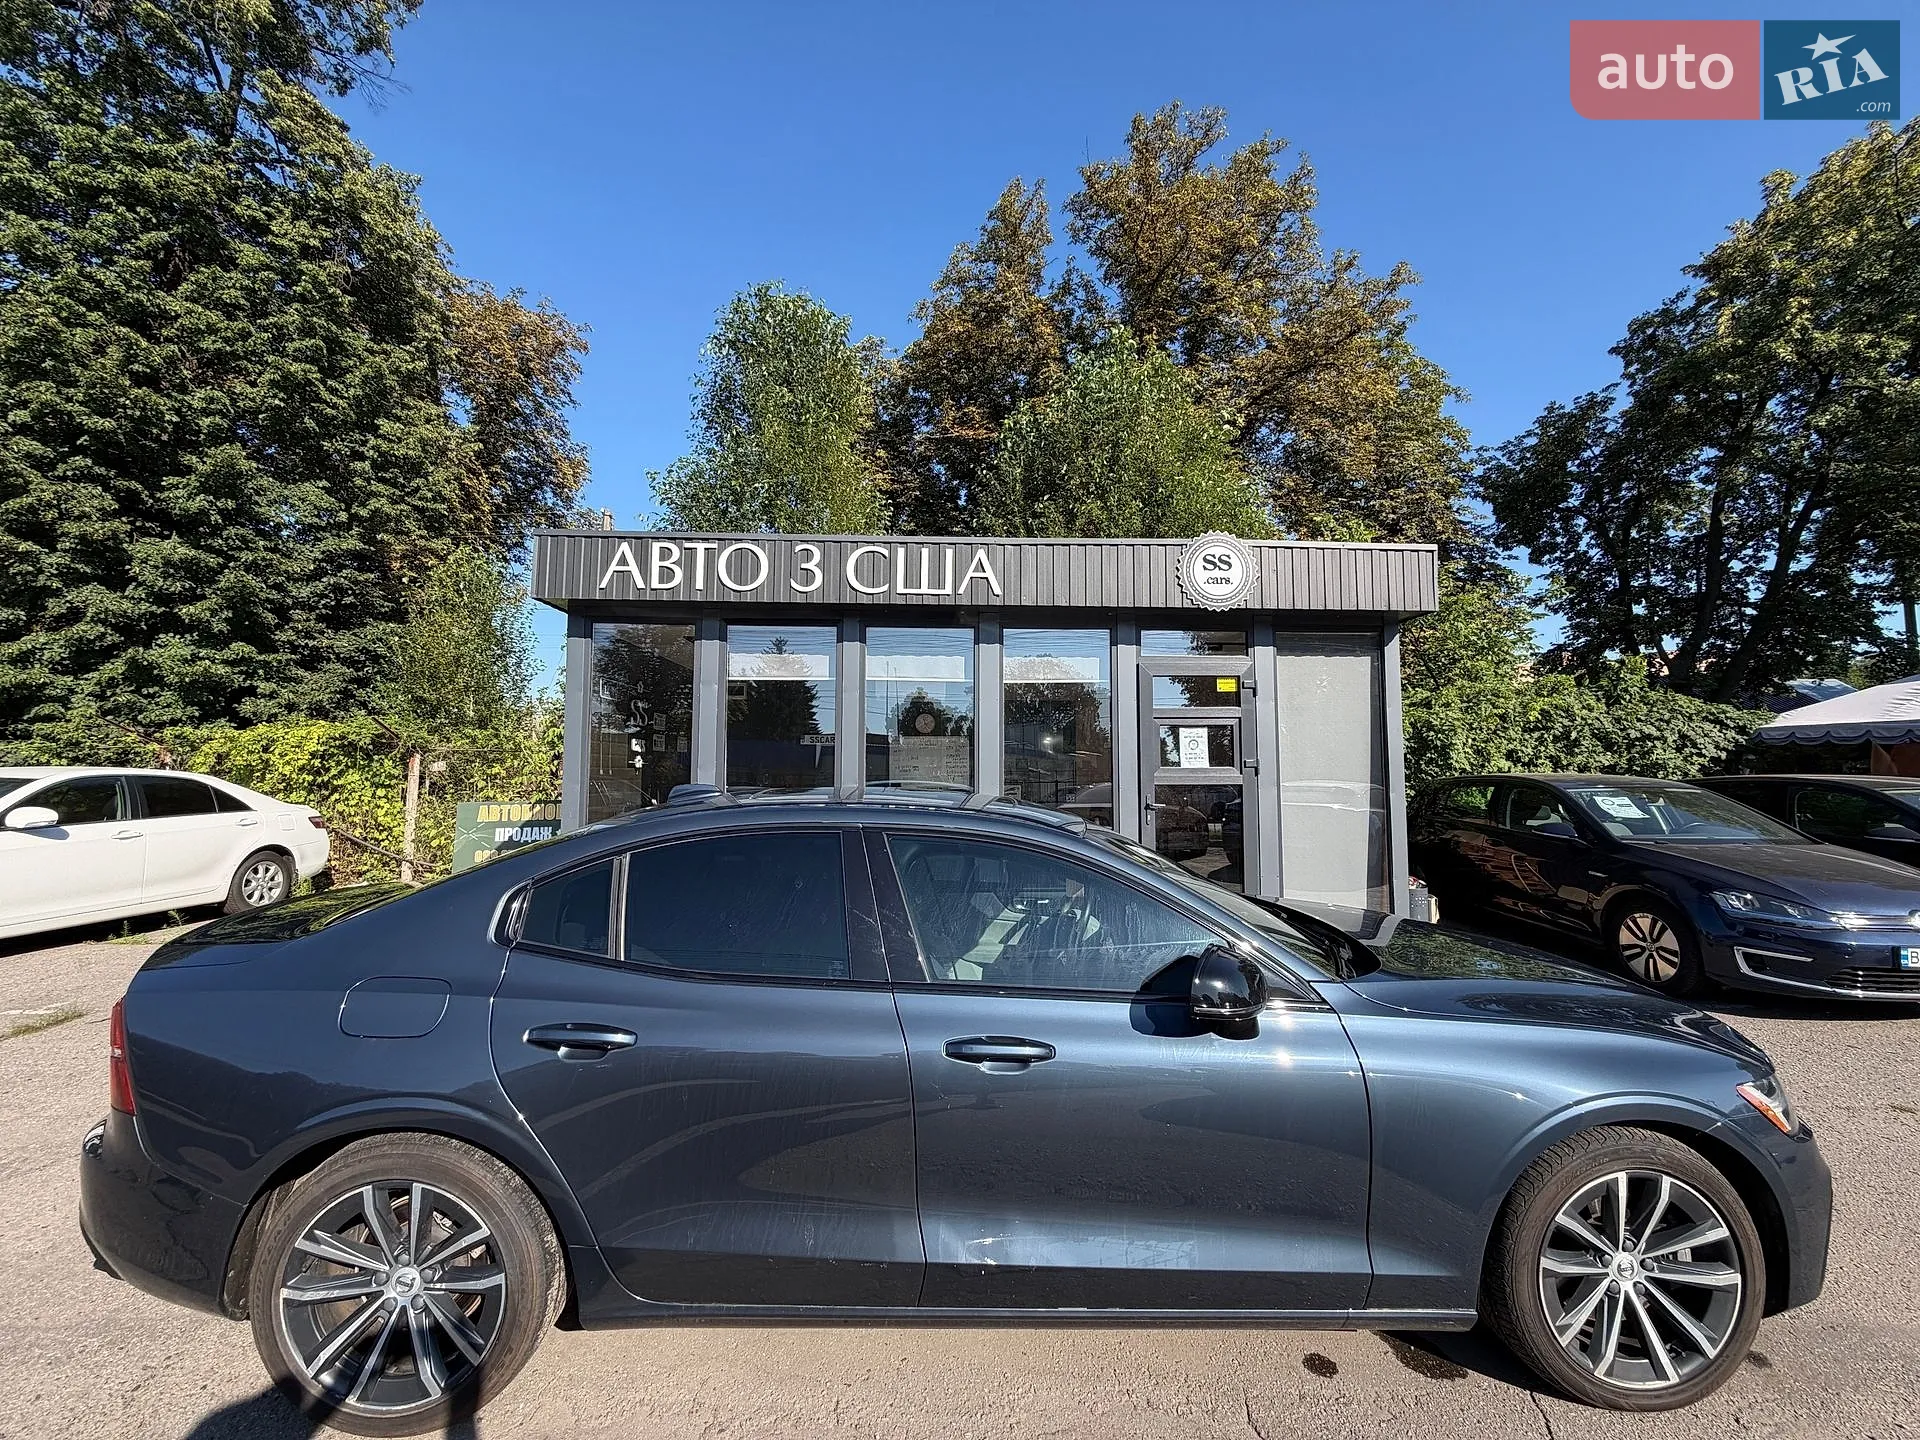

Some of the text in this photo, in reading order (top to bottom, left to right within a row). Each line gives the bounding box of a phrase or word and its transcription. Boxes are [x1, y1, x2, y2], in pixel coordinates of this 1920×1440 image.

[599, 541, 1005, 597] АВТО З США
[1202, 554, 1232, 571] SS
[494, 826, 553, 842] ПРОДАЖ
